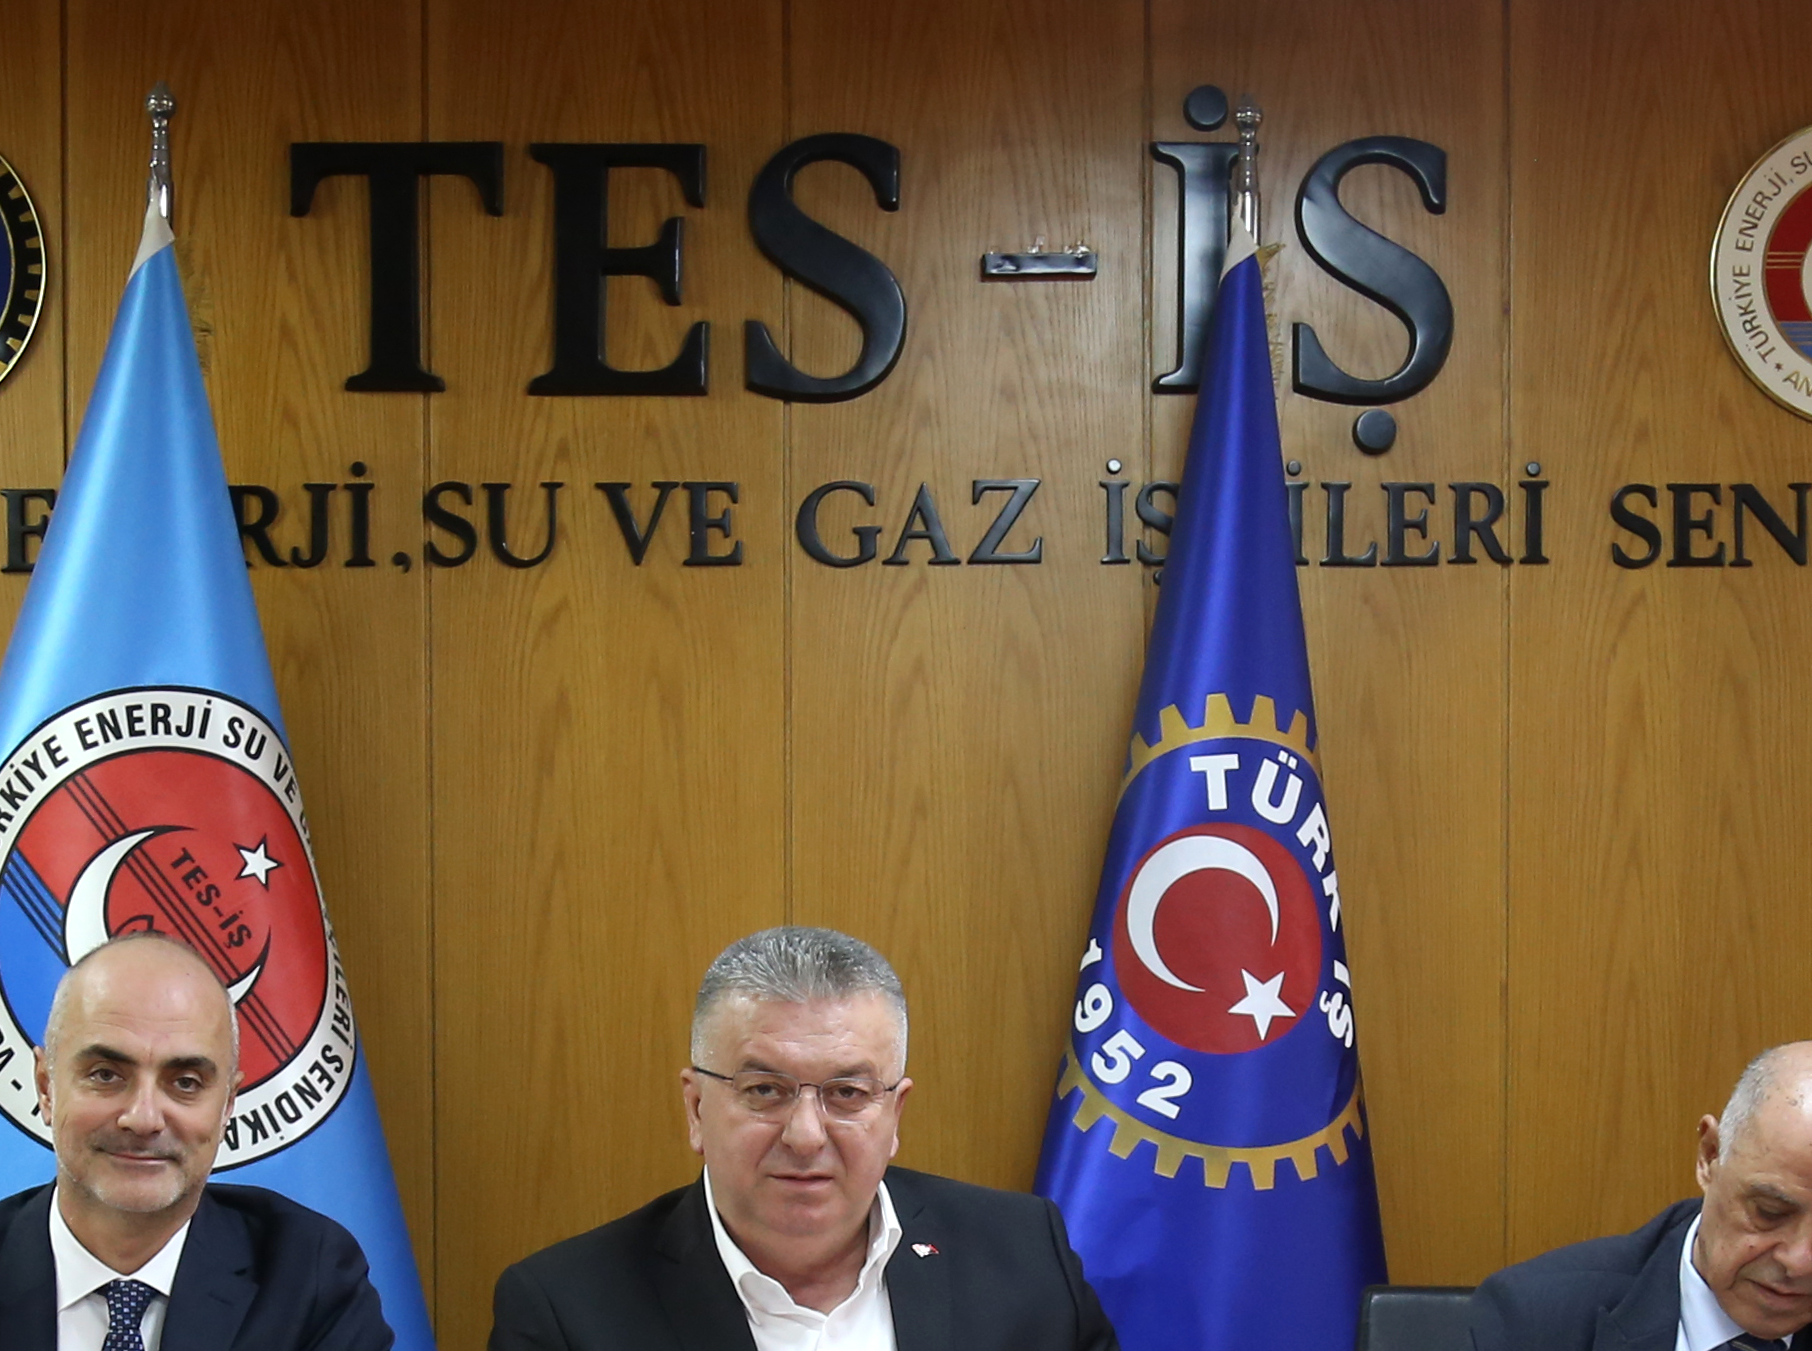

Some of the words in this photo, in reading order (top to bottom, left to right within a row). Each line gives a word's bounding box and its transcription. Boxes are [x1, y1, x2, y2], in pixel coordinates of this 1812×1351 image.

[1735, 166, 1795, 252] ENERJİ,
[290, 131, 906, 404] TES
[1150, 84, 1454, 455] İŞ
[1727, 264, 1777, 366] TÜRKİYE
[595, 480, 744, 568] VE
[796, 478, 1043, 568] GAZ
[74, 698, 214, 749] ENERJİ
[221, 714, 268, 762] SU
[271, 757, 298, 806] VE
[169, 847, 255, 950] TES-İŞ
[1073, 937, 1194, 1121] 1952
